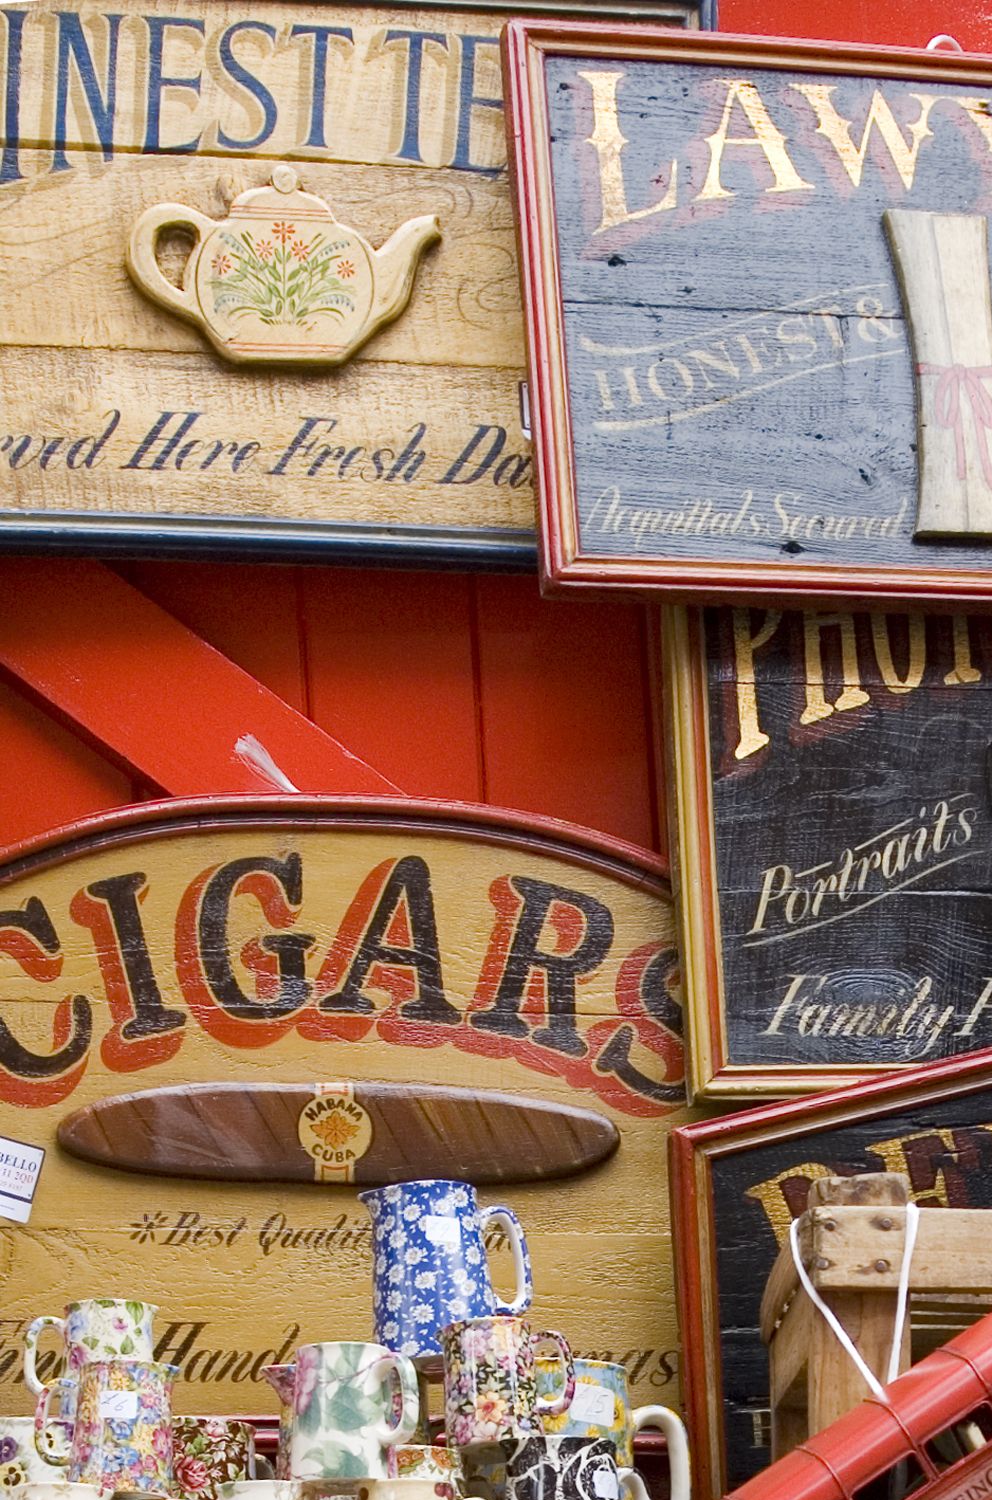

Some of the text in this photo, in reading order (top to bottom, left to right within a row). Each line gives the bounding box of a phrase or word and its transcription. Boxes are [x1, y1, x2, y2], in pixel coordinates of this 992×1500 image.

[594, 295, 903, 412] HONEST &
[118, 410, 262, 474] Here
[264, 416, 428, 484] Fresh
[436, 423, 534, 492] Da
[582, 485, 908, 548] Acquittals Secured
[746, 796, 980, 936] Portraits
[0, 852, 685, 1102] CIGARS
[758, 972, 956, 1060] Family
[304, 1098, 363, 1121] HABANA
[311, 1143, 356, 1162] CUBA
[159, 1210, 372, 1256] Best Qualit
